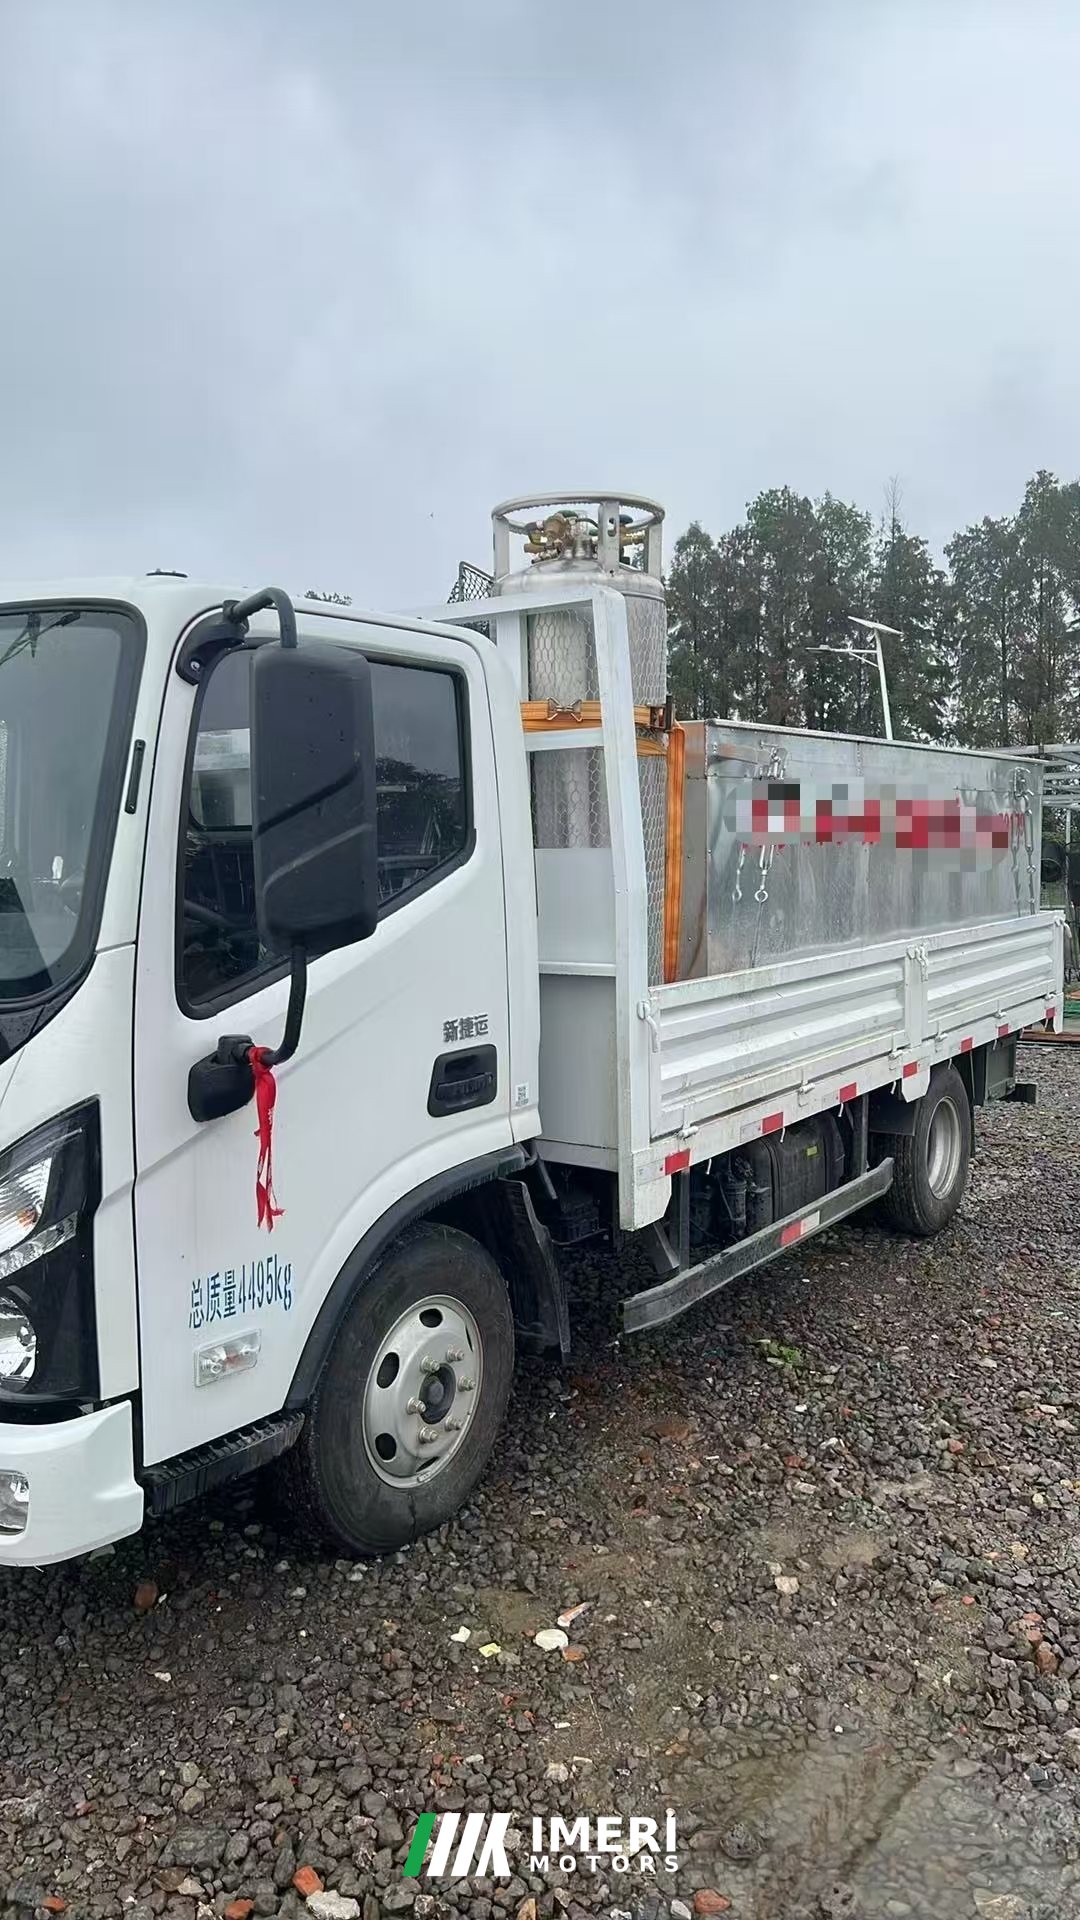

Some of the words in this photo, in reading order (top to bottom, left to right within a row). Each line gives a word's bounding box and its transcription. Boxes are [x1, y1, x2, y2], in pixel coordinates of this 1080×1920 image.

[443, 1013, 488, 1042] 新捷运
[189, 1254, 292, 1328] 总质量4495kg
